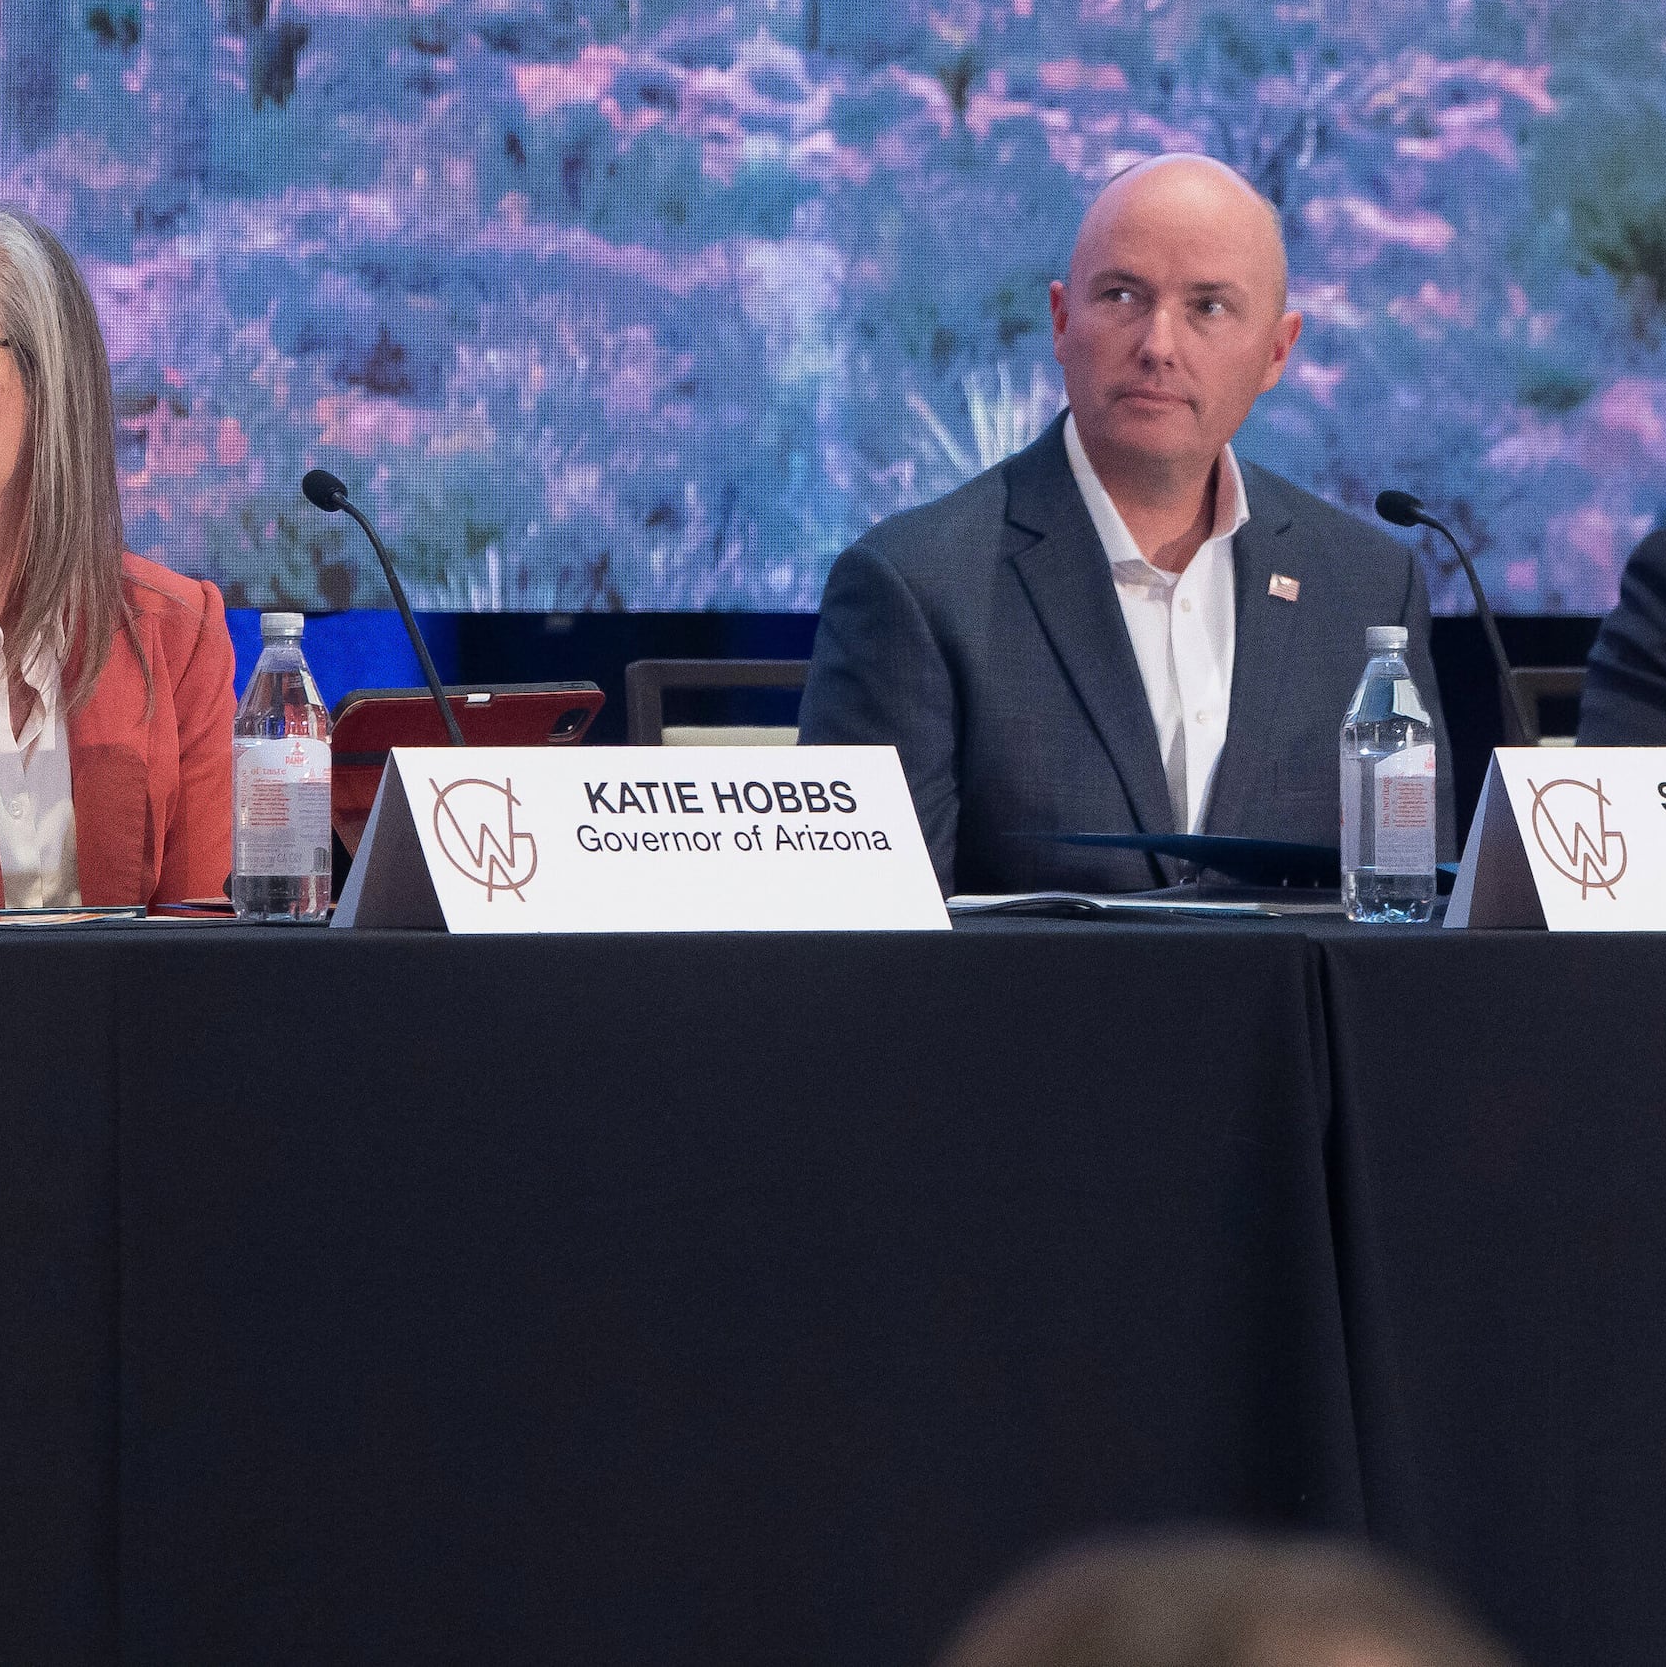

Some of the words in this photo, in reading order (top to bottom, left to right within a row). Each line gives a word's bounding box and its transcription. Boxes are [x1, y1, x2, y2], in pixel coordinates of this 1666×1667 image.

[583, 781, 704, 815] KATIE
[710, 780, 858, 815] HOBBS
[576, 824, 722, 853] Governor
[733, 824, 763, 852] of
[775, 823, 893, 852] Arizona
